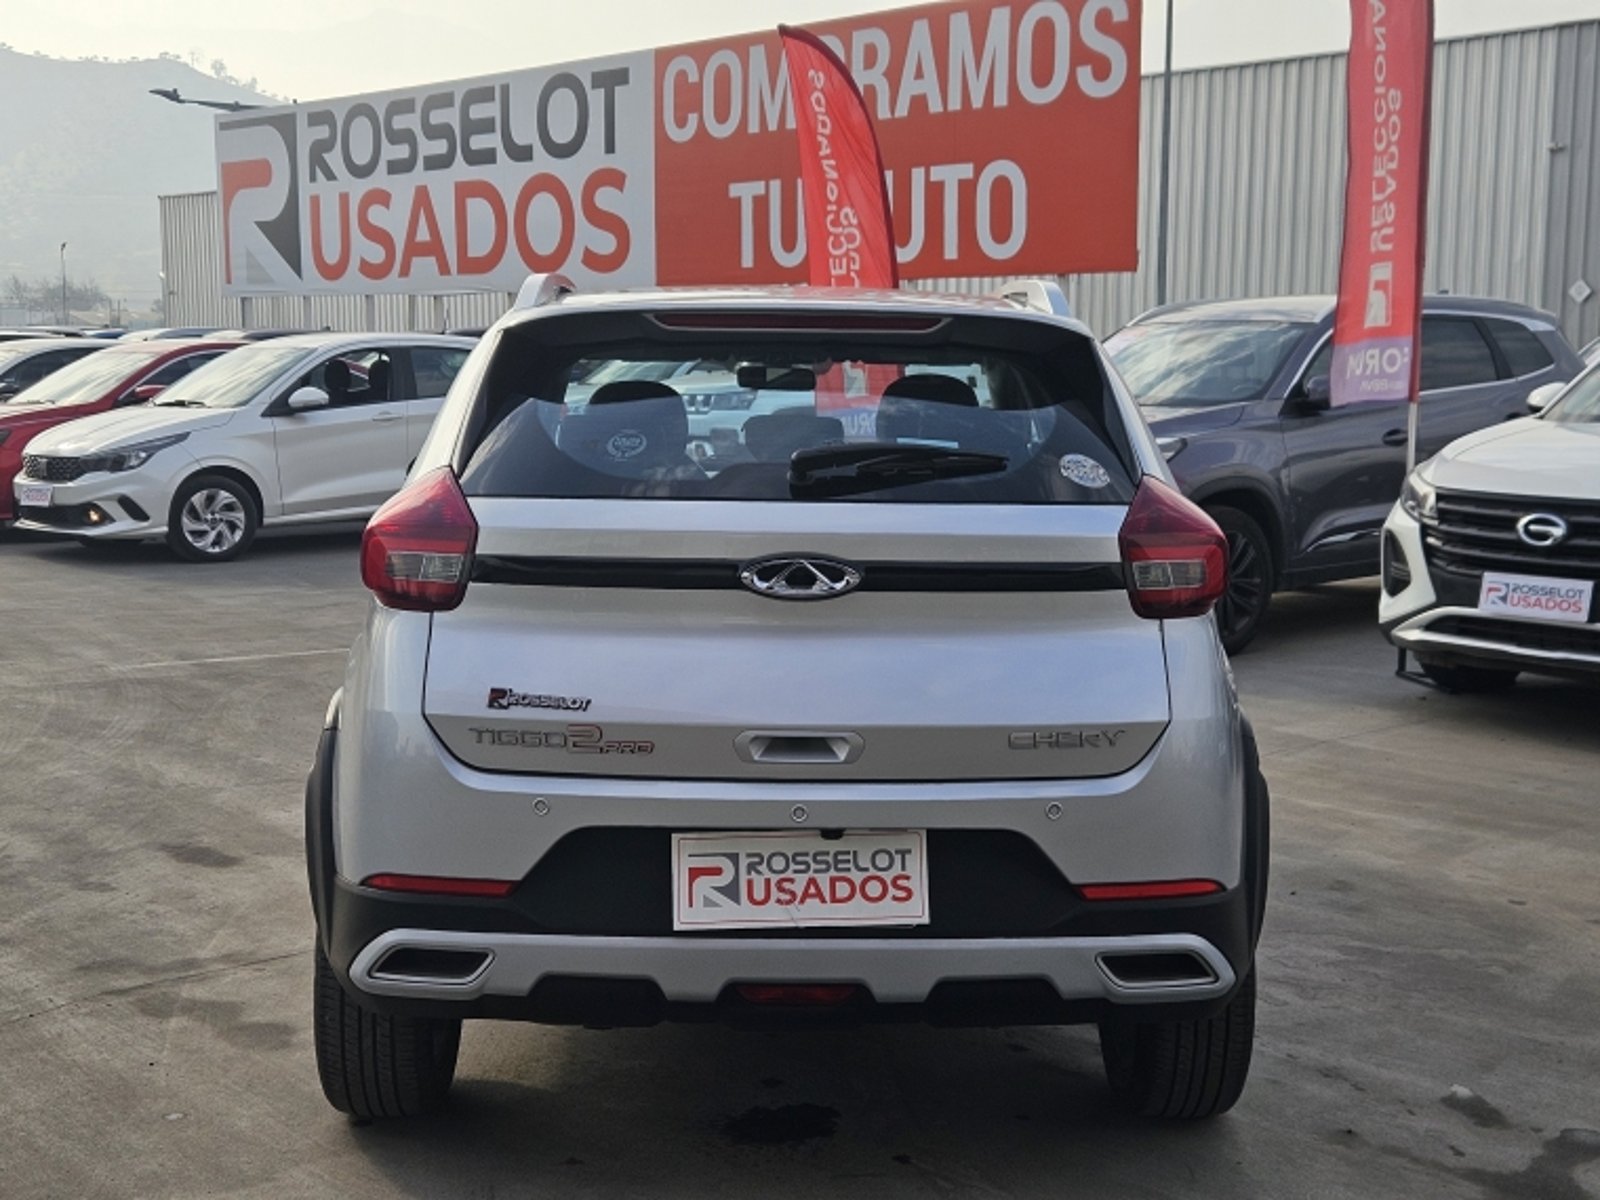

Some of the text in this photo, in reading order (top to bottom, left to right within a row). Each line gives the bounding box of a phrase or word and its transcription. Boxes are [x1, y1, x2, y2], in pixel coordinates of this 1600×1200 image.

[662, 0, 1129, 144] COMRAMOS
[307, 66, 630, 184] ROSSELOT
[309, 167, 631, 282] USADOS
[728, 159, 1028, 269] TU UTO
[1509, 595, 1584, 614] USADOS
[1510, 582, 1585, 600] ROSSELOT
[1007, 729, 1127, 750] CHERY
[745, 848, 912, 876] ROSSELOT
[746, 873, 915, 907] USADOS
